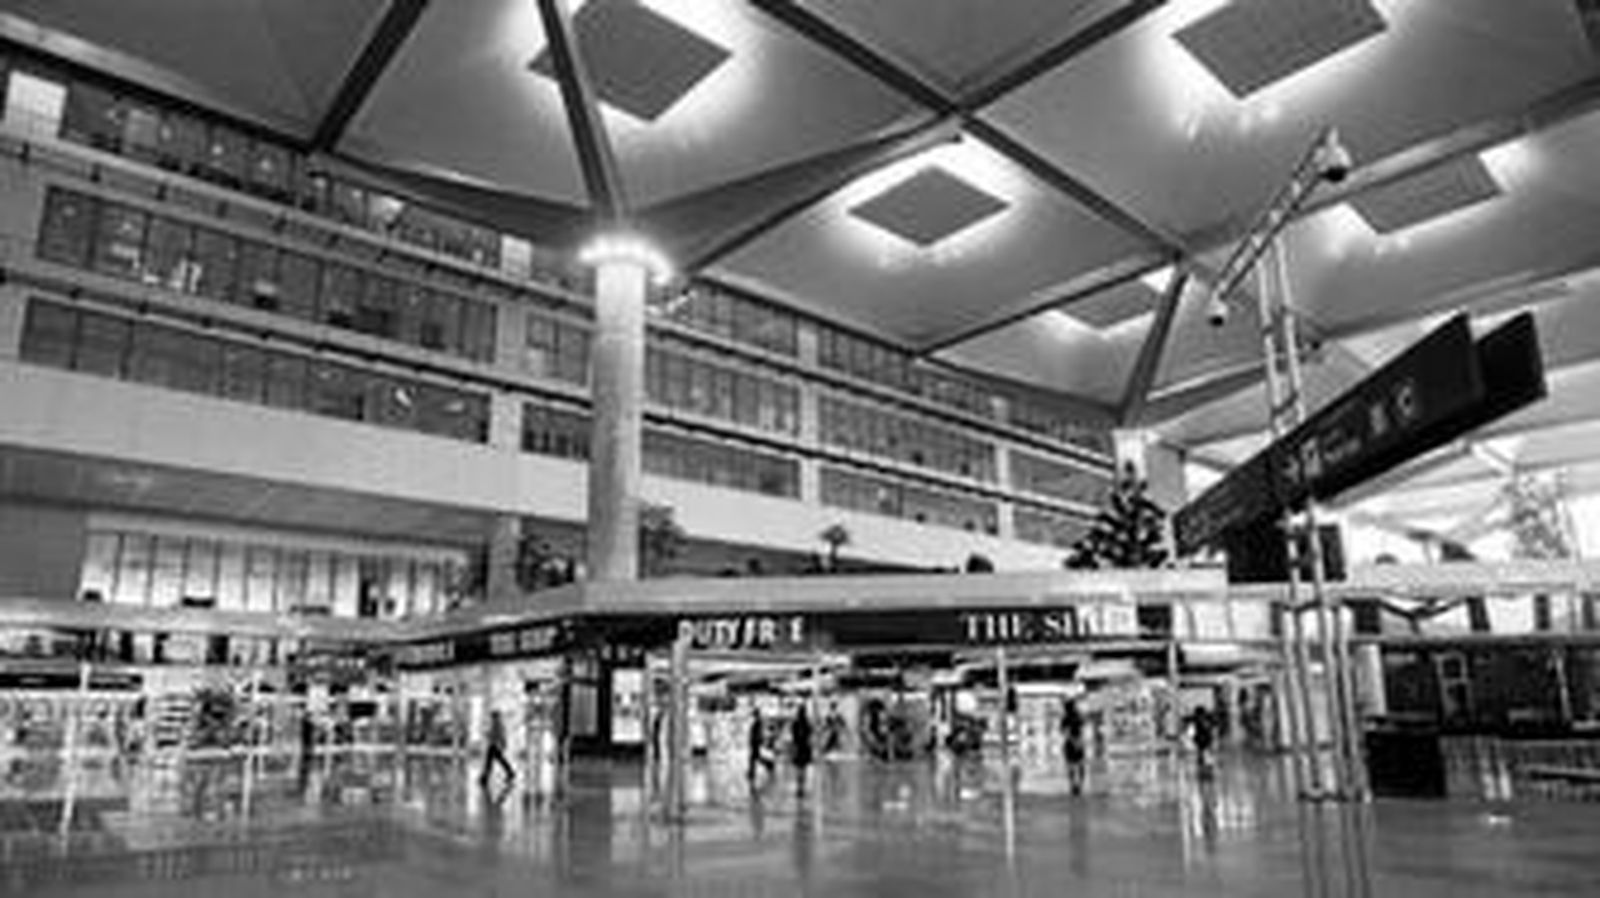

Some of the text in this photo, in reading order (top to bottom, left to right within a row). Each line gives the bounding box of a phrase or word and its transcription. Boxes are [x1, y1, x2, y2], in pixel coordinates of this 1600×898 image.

[677, 616, 804, 646] DUTY FRE
[960, 612, 1035, 640] THE
